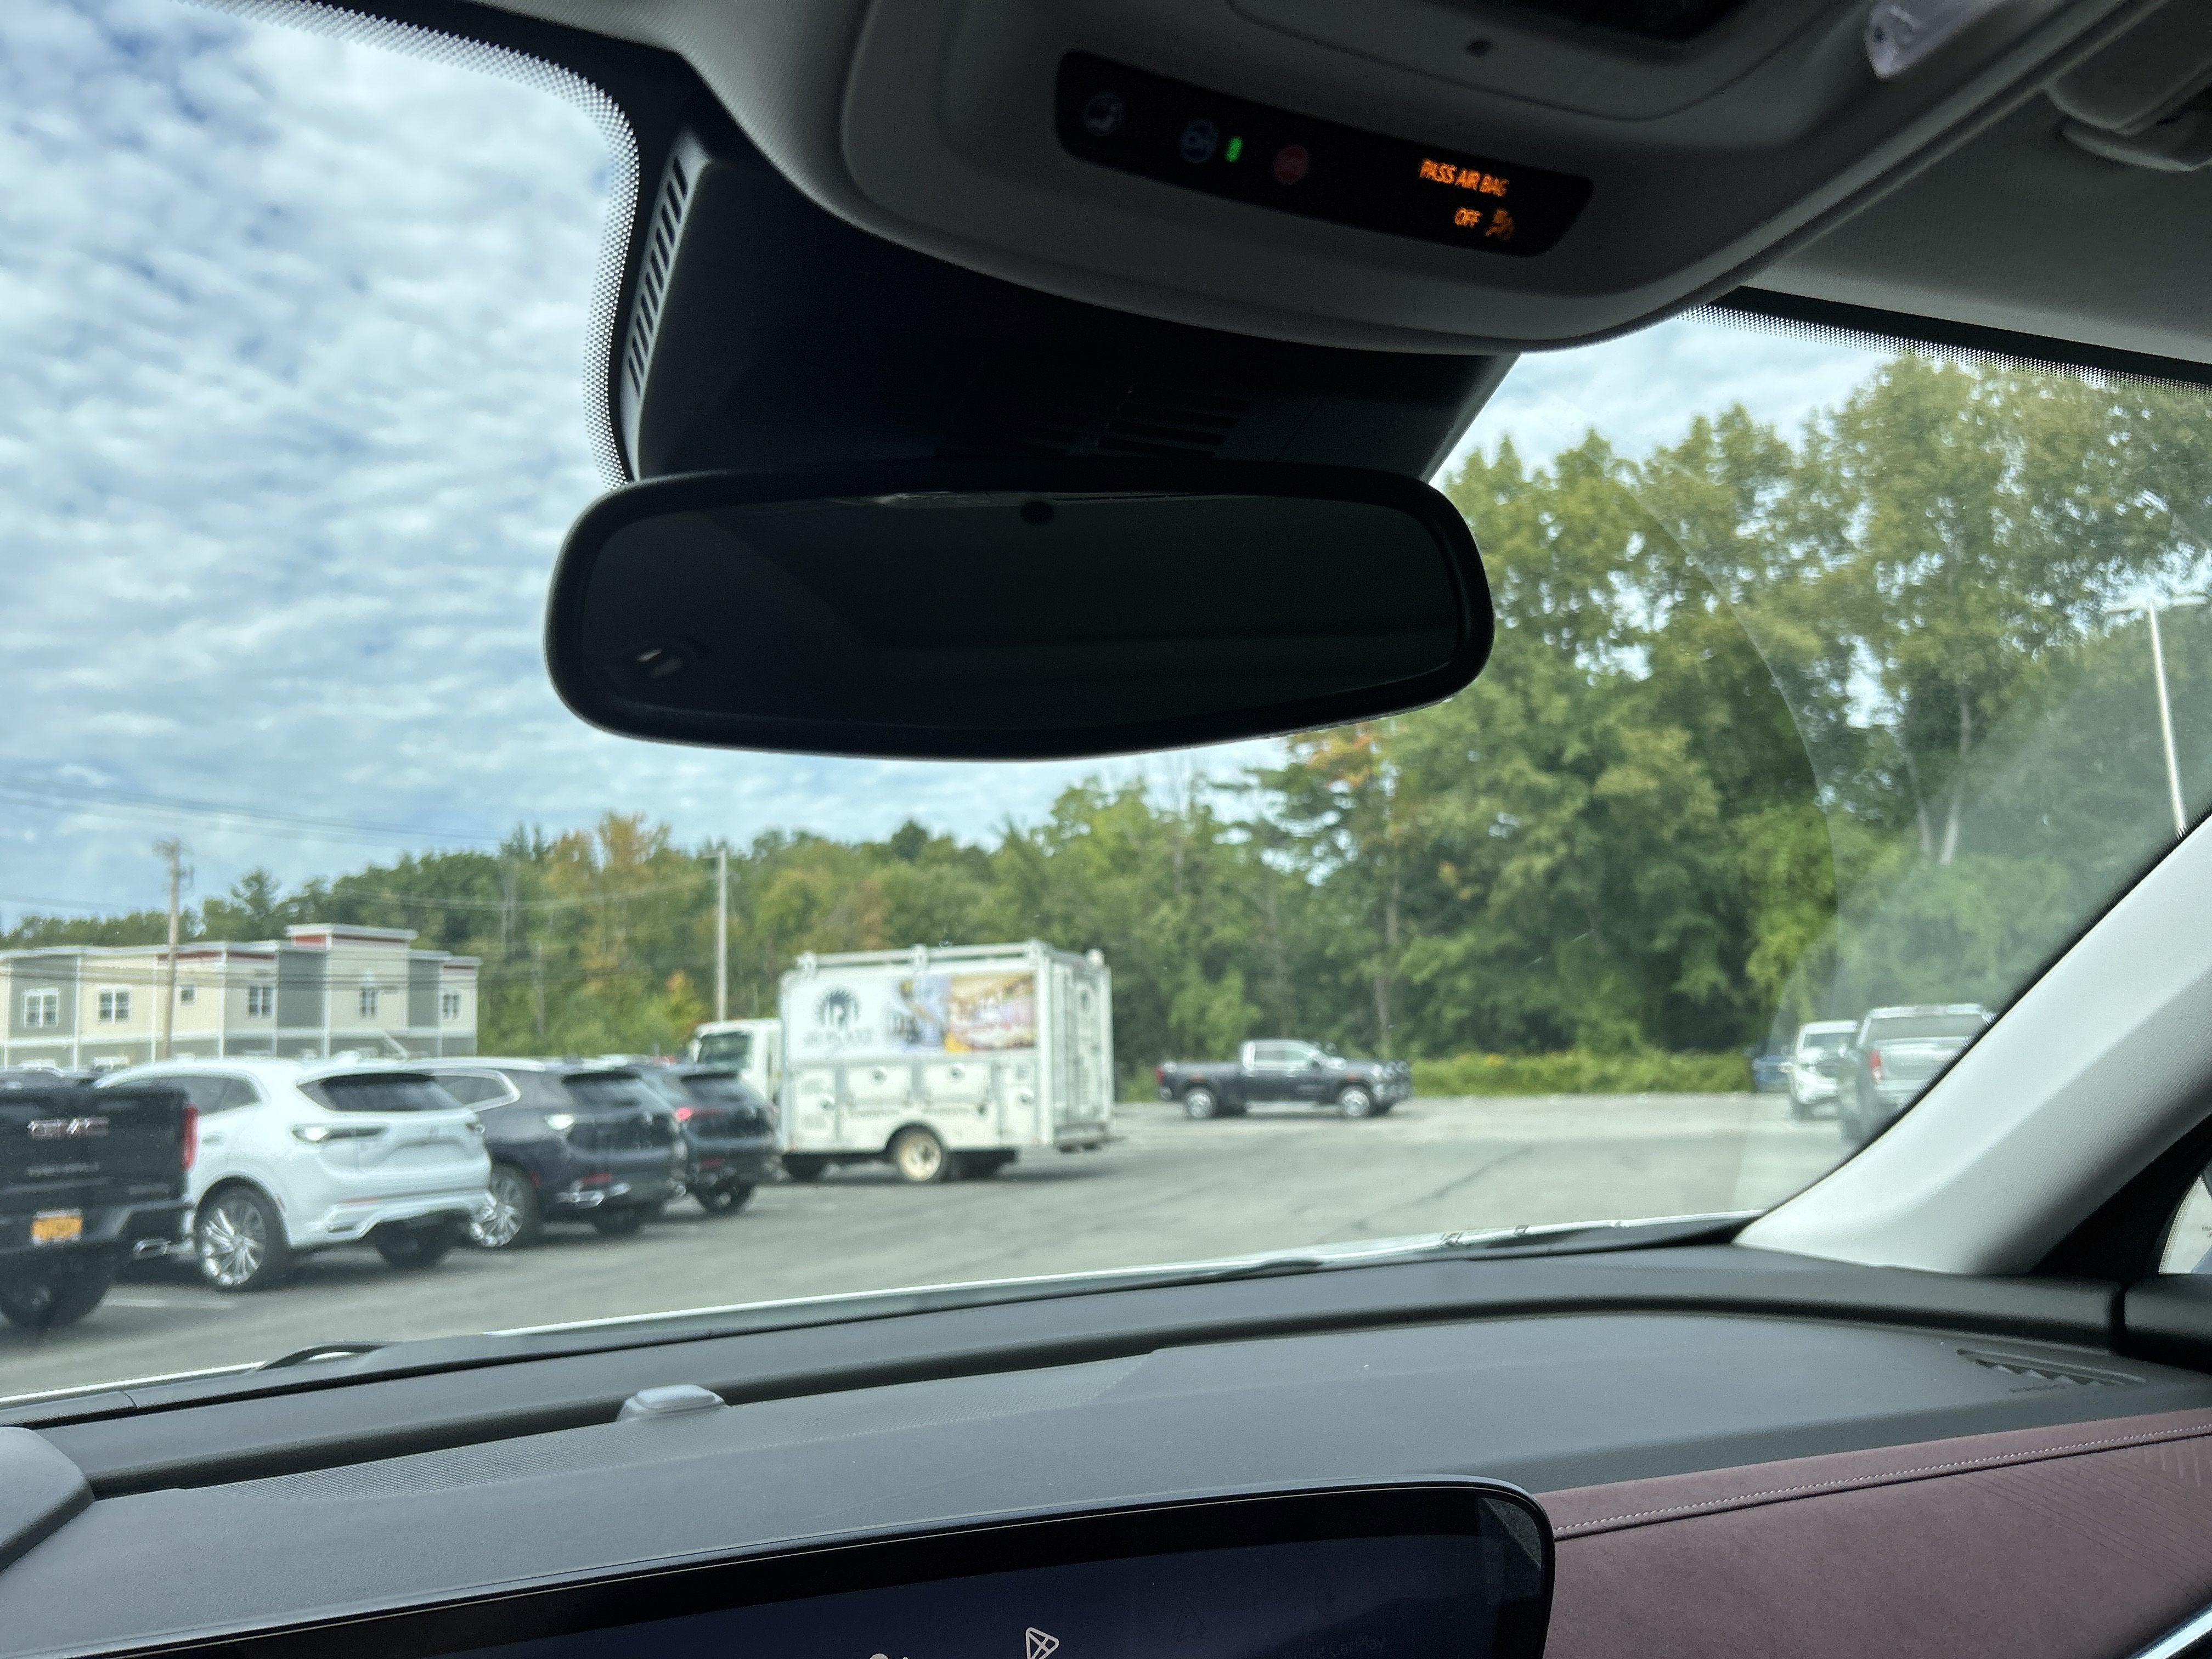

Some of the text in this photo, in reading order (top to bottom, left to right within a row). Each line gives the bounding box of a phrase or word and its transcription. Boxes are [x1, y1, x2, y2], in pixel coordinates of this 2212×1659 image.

[1420, 159, 1508, 196] PASS AIR BAG
[1455, 208, 1482, 228] OFF
[1329, 1635, 1384, 1656] CarPlay
